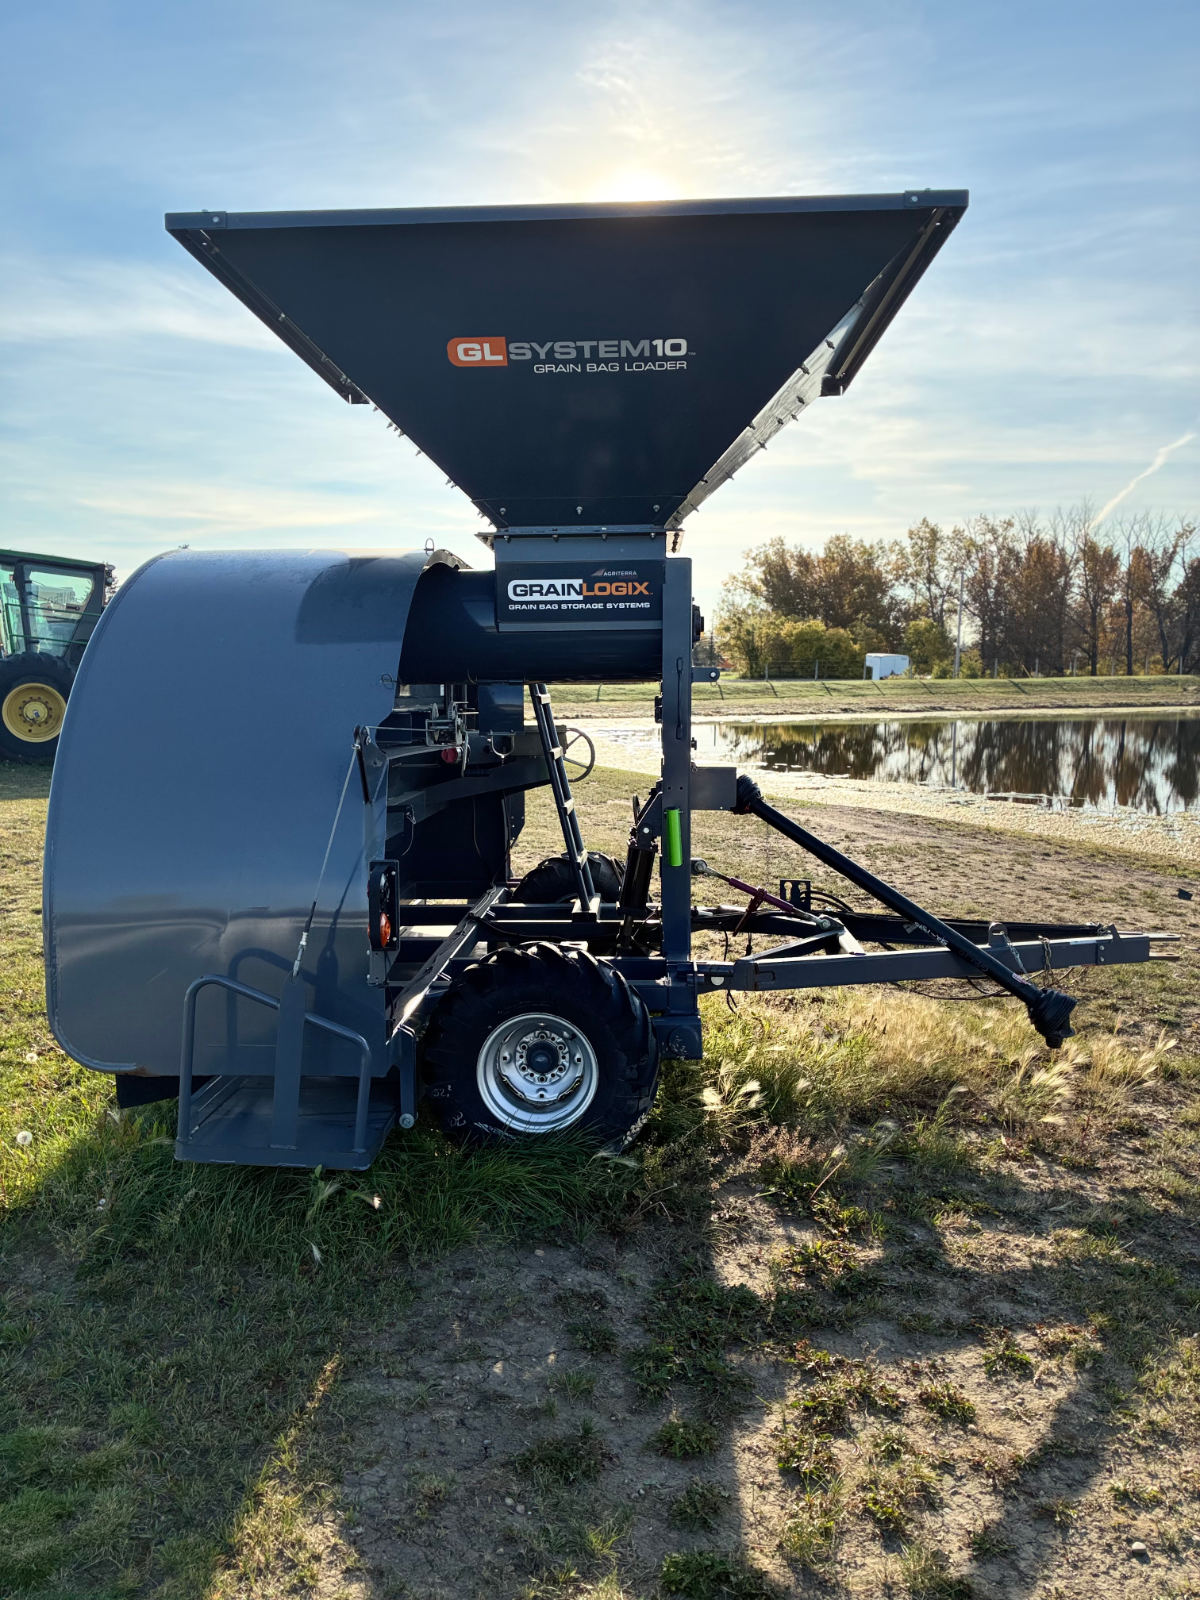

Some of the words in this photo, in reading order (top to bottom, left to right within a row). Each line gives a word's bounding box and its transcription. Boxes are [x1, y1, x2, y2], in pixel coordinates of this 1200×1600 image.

[533, 363, 582, 374] GRAIN
[586, 362, 620, 373] BAG
[624, 360, 687, 372] LOADER
